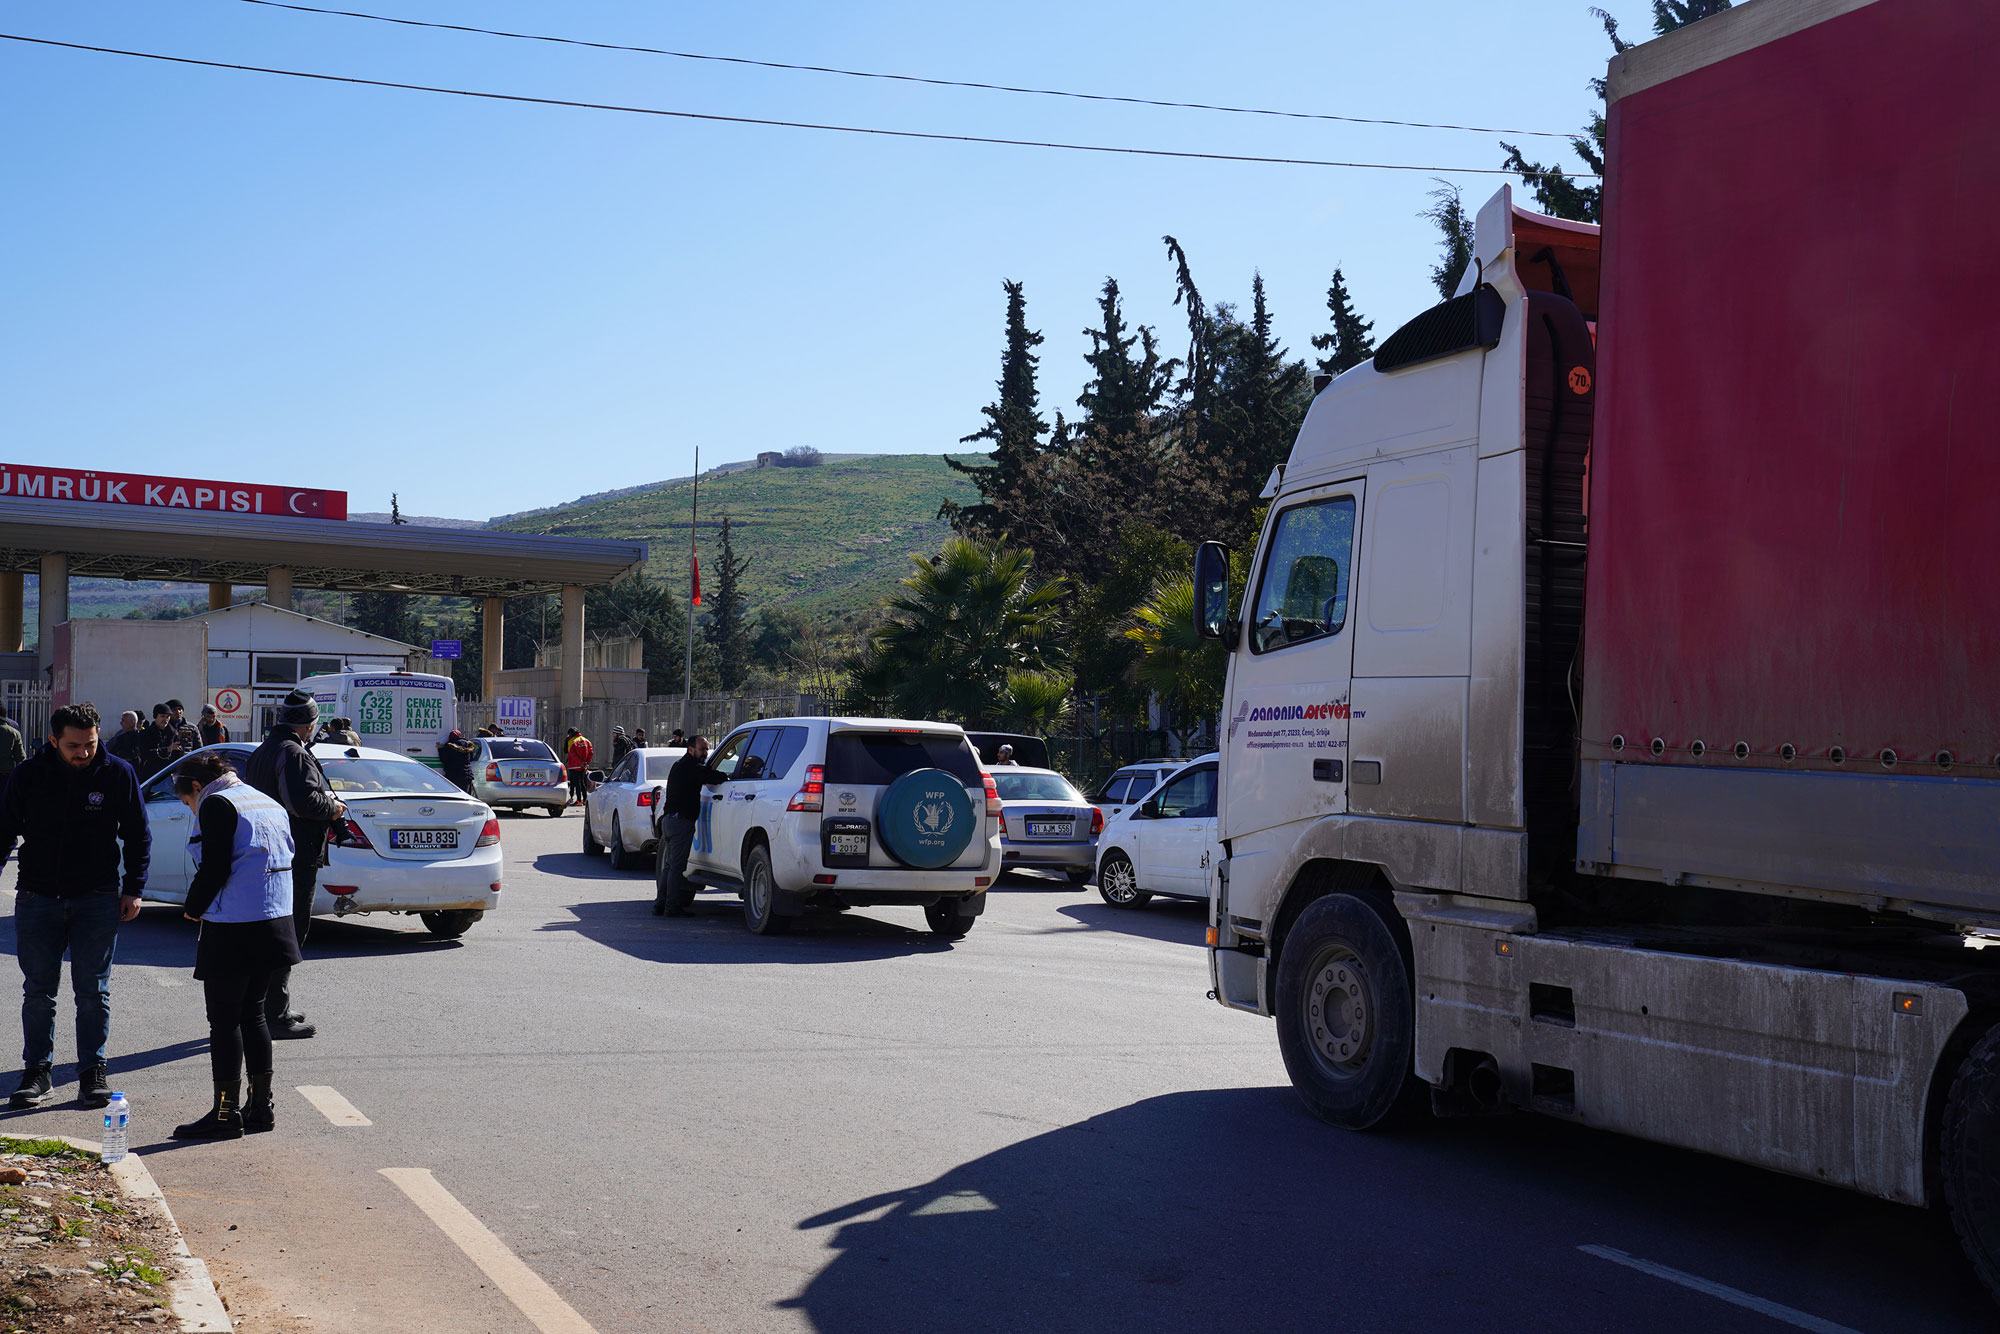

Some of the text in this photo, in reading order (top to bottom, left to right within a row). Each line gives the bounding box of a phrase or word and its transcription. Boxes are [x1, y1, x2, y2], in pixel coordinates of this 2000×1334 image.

[1573, 372, 1587, 387] 70
[144, 483, 263, 513] KAPISI
[376, 690, 393, 698] 0262
[370, 697, 393, 708] 322
[406, 698, 442, 708] CENAZE
[502, 699, 530, 717] TIR
[359, 709, 393, 720] 15 25
[1353, 710, 1366, 719] mv
[368, 722, 391, 733] 188
[406, 719, 442, 729] ARACI
[925, 791, 945, 799] WFP
[1033, 824, 1040, 834] 31
[398, 831, 455, 844] 31 ALB 839
[832, 835, 843, 844] 06
[839, 844, 858, 852] 2012
